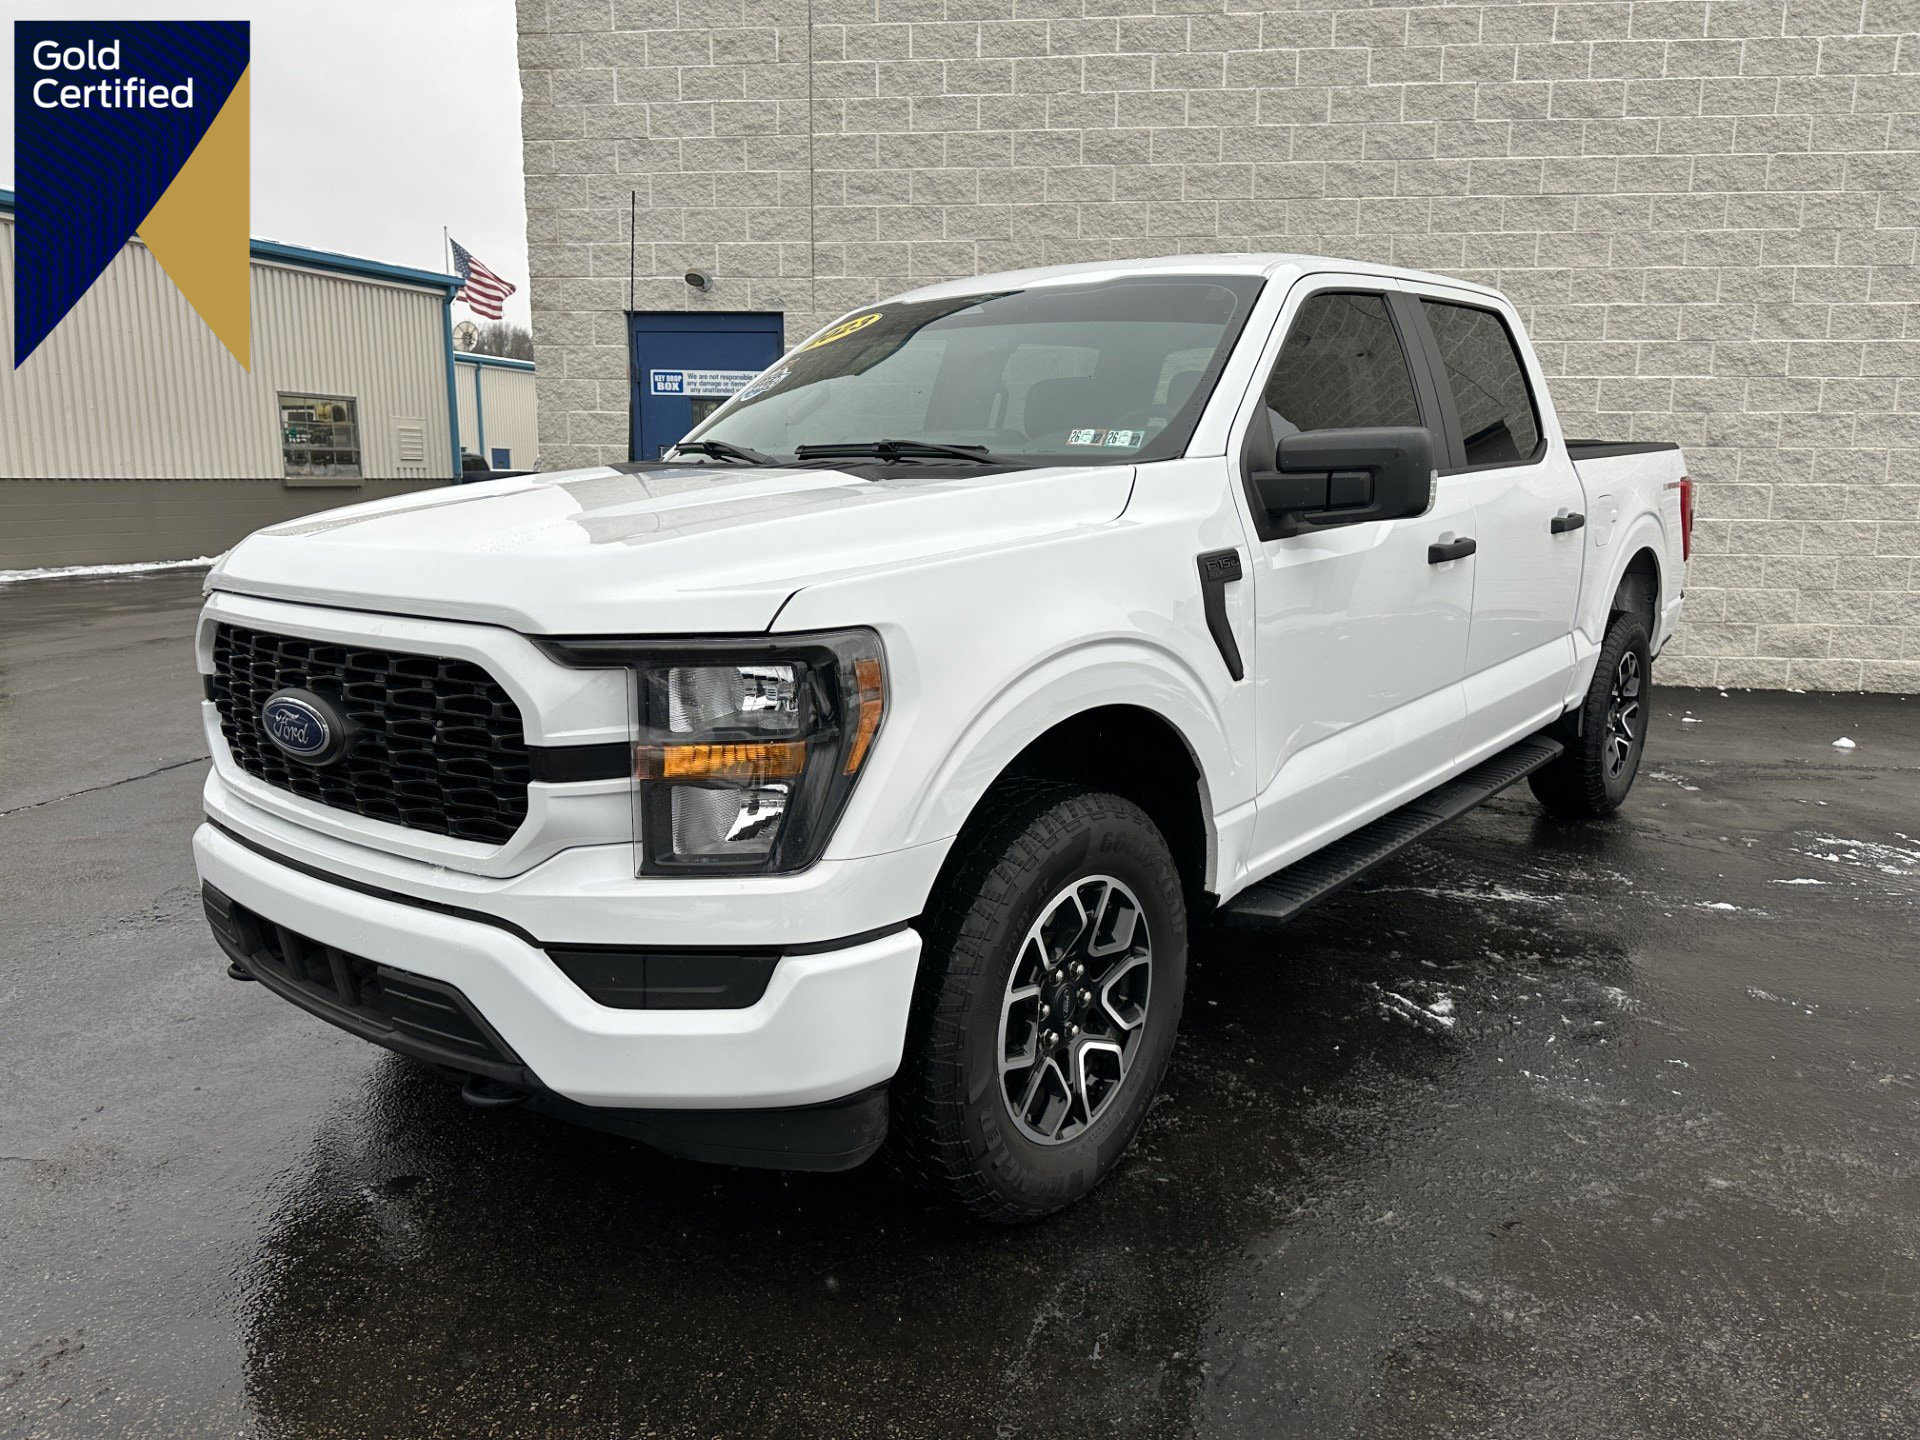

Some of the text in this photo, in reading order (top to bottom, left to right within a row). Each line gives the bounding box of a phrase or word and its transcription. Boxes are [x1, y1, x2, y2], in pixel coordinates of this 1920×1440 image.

[720, 373, 753, 381] responsible
[657, 382, 680, 391] BOX
[1070, 431, 1082, 442] 26
[1108, 432, 1119, 443] 26
[273, 708, 310, 744] Ford
